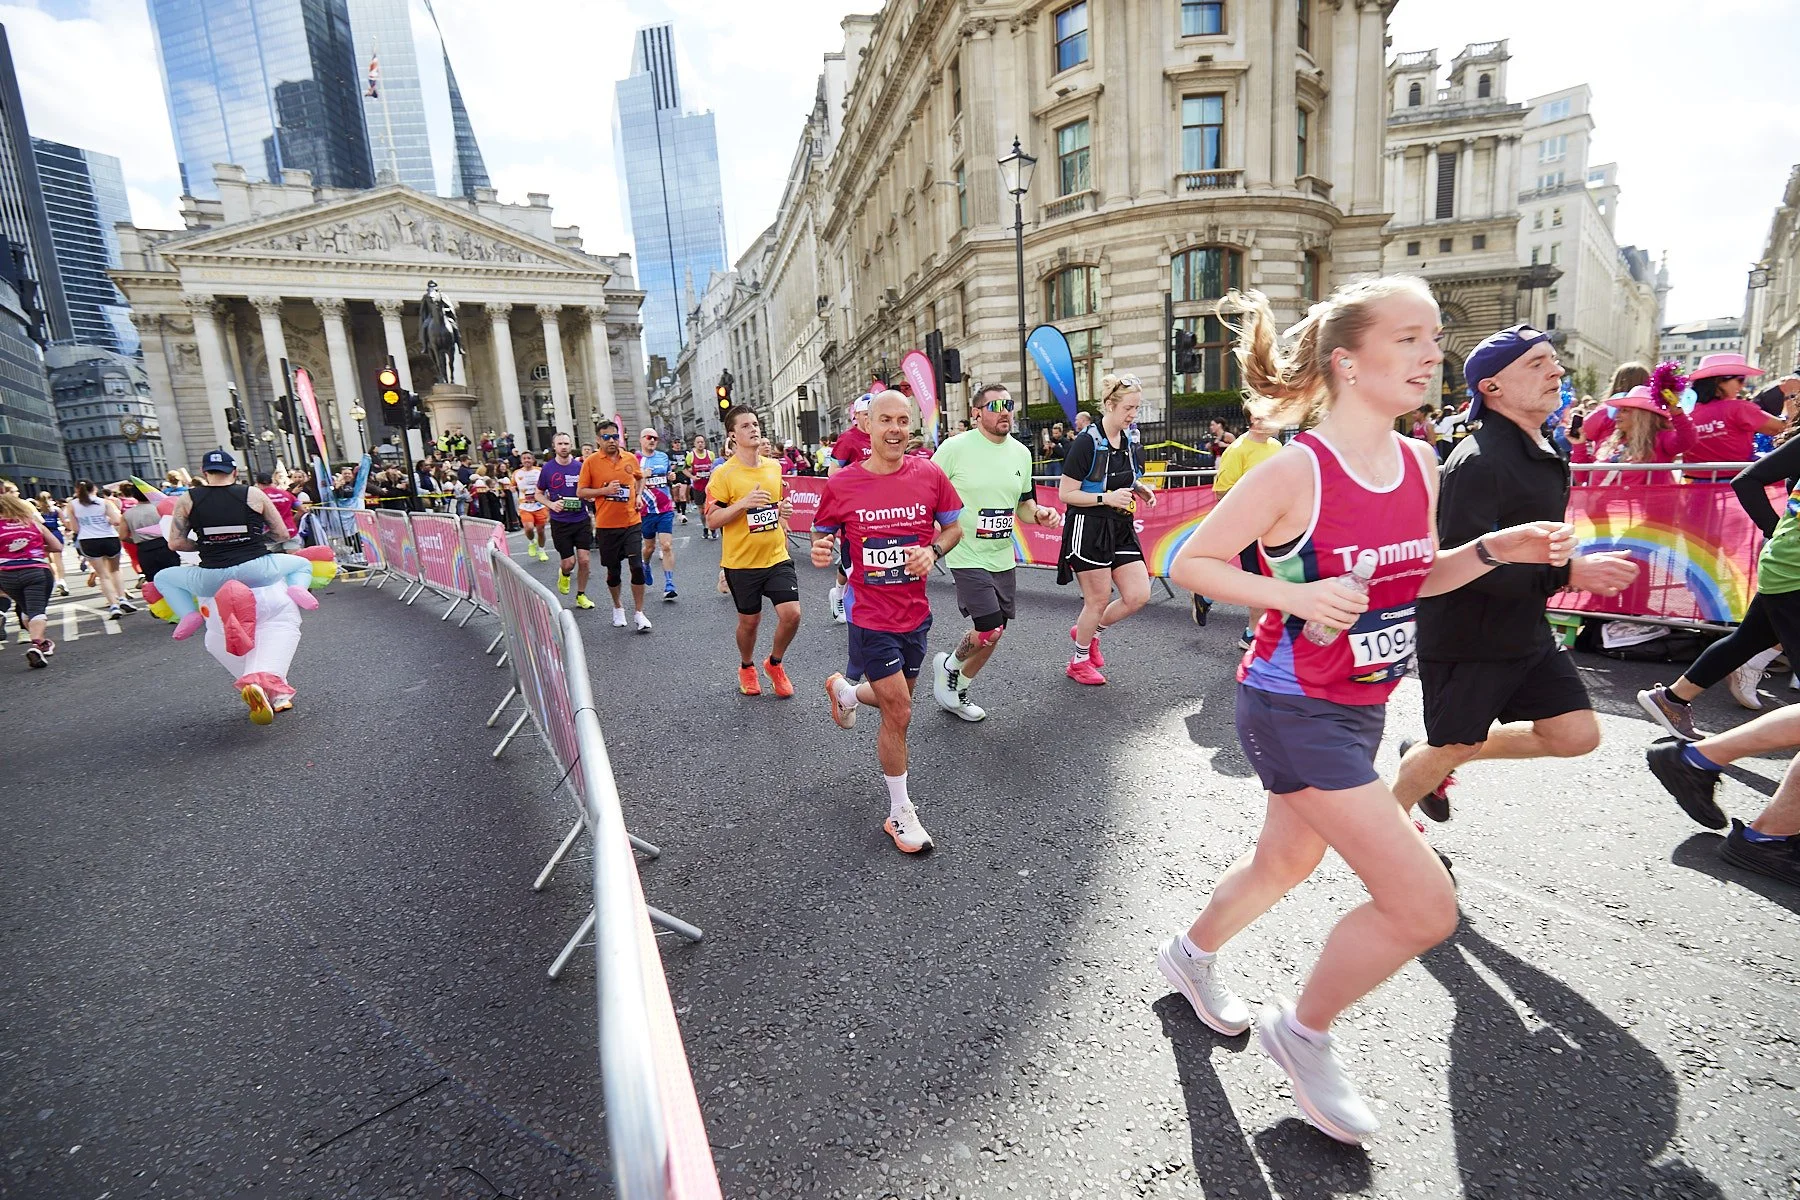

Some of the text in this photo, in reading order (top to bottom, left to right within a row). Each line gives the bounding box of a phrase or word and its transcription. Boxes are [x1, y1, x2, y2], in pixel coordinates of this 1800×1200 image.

[789, 489, 821, 508] Tommy
[753, 510, 777, 524] 9621
[855, 503, 927, 522] Tommy's
[981, 517, 1013, 529] 11592
[1033, 531, 1063, 542] The pregn
[867, 549, 906, 565] 1041
[1333, 532, 1434, 572] Tommy
[1361, 628, 1413, 662] 109
